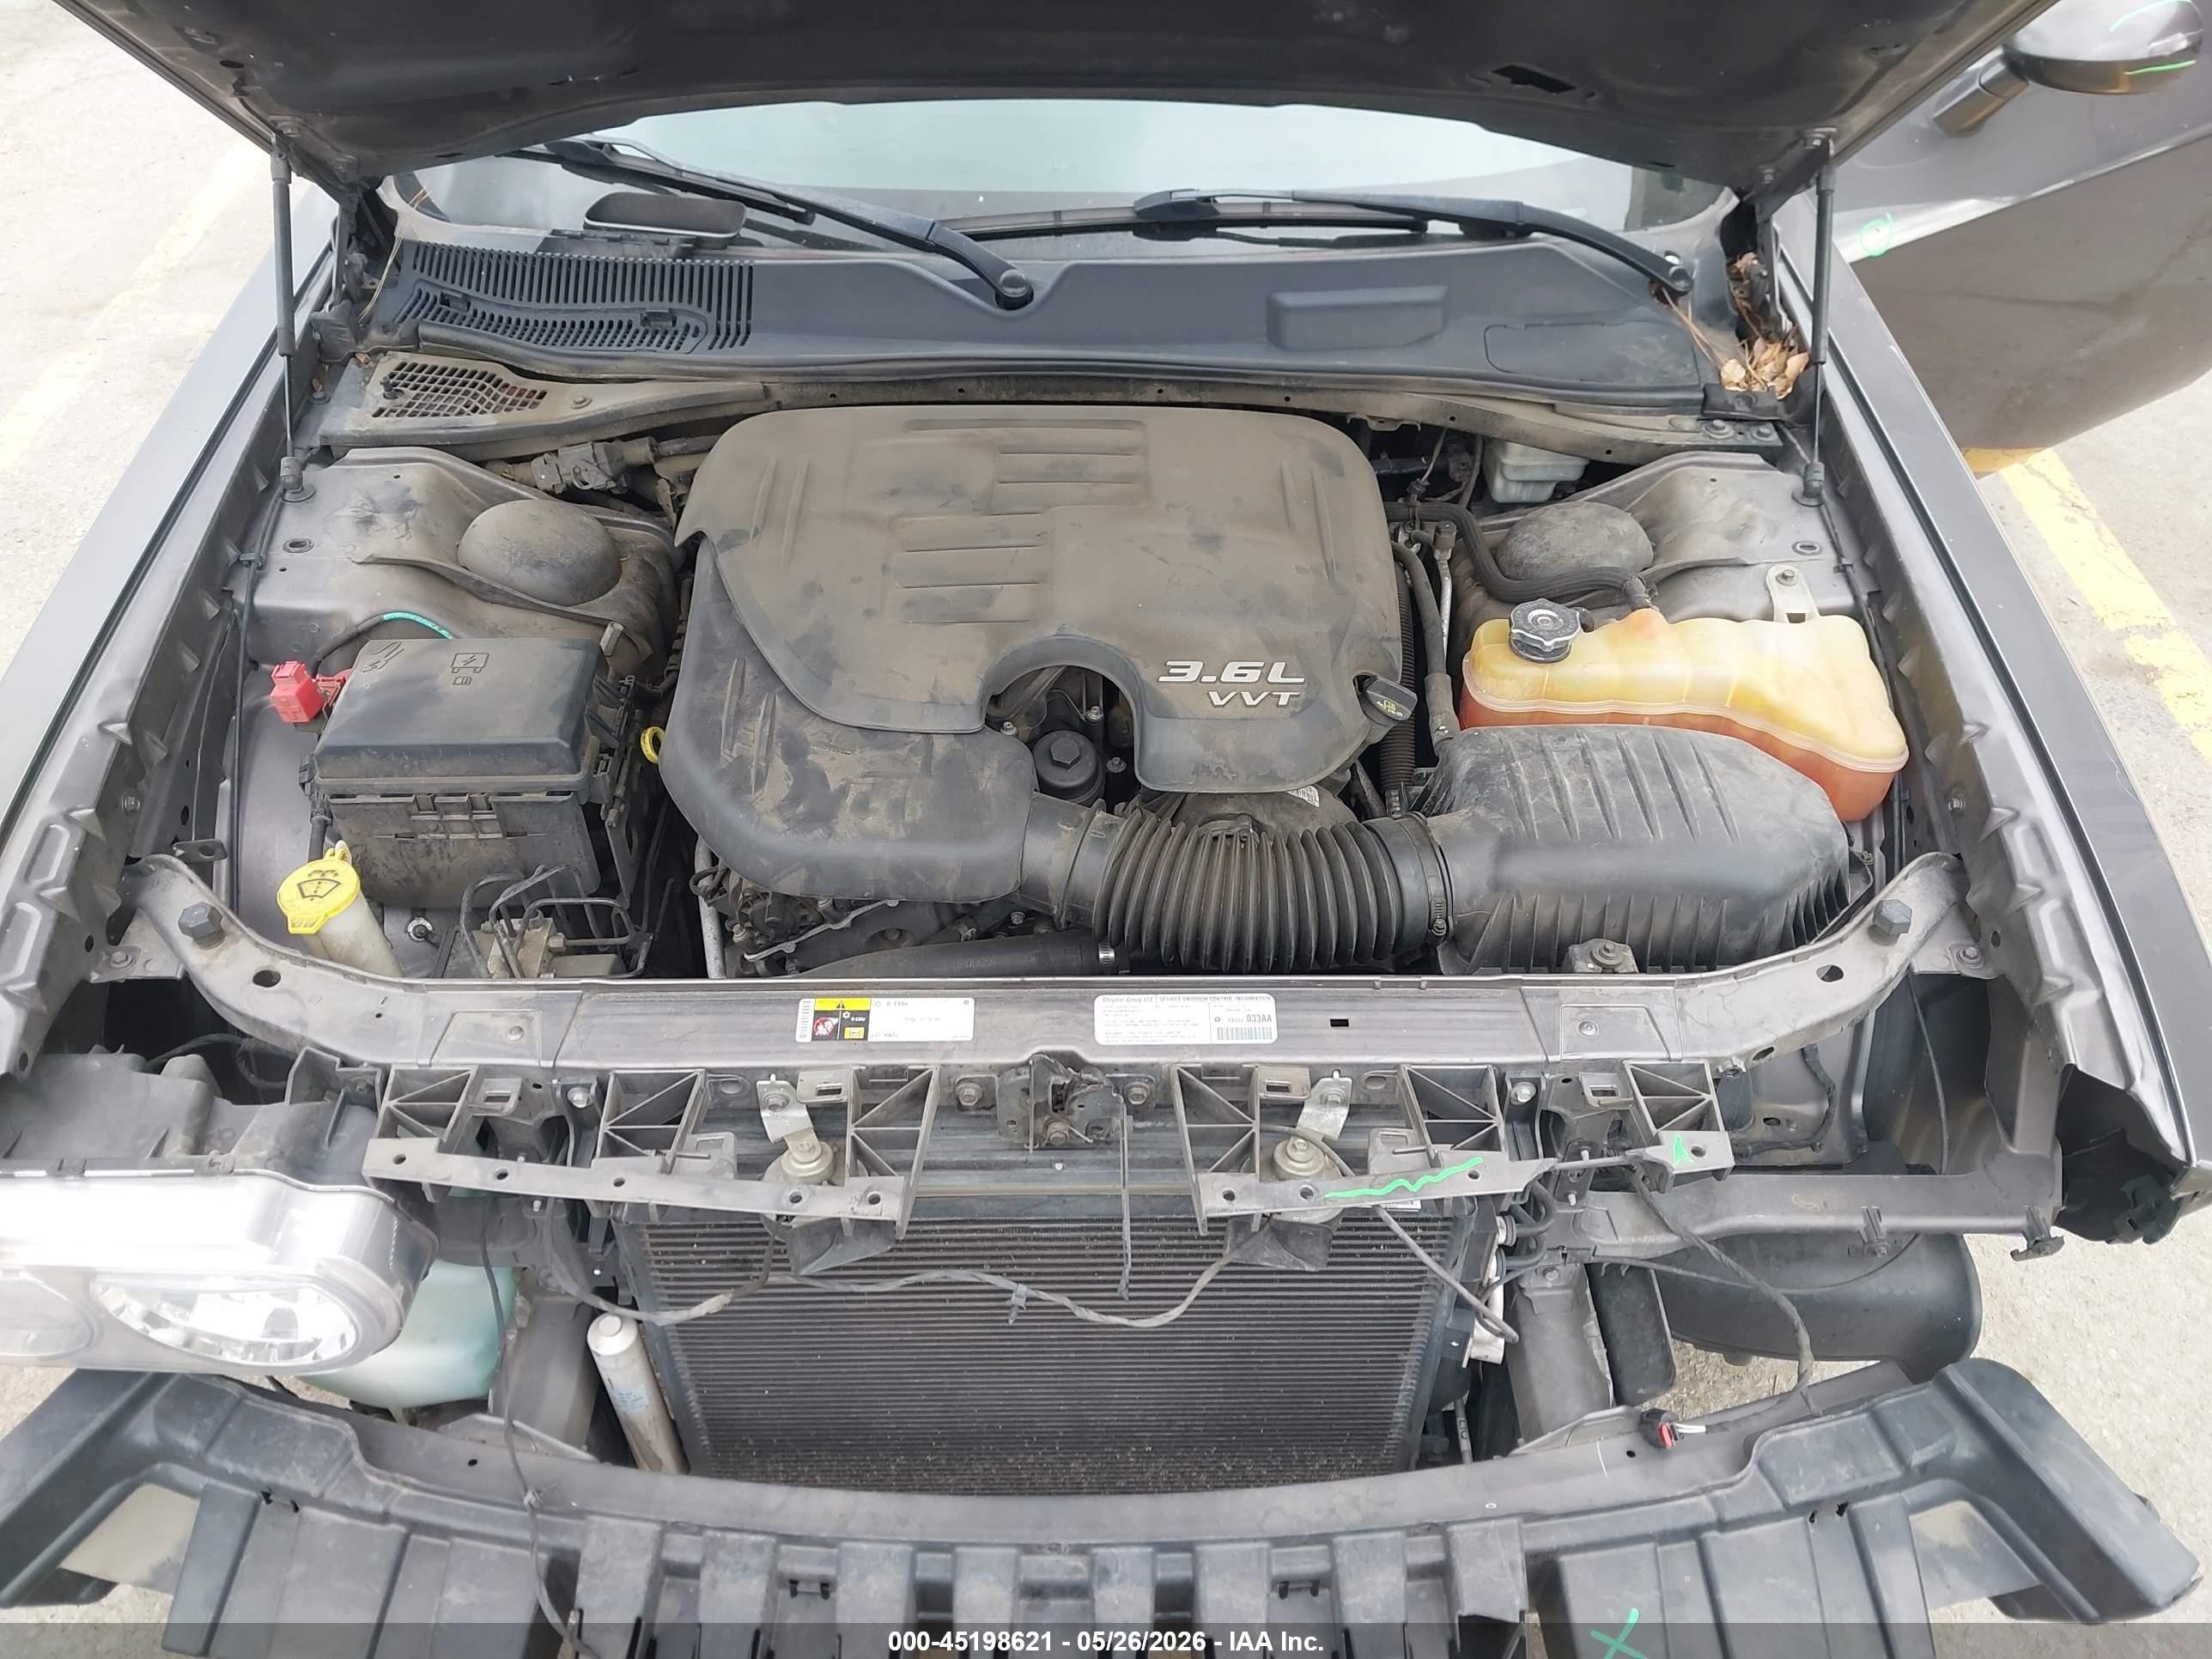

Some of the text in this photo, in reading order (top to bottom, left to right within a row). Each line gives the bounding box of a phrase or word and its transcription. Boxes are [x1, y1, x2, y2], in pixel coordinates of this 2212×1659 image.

[1158, 660, 1305, 683] 3.6L
[1208, 691, 1300, 707] VVT
[1246, 1013, 1273, 1023] 033AA
